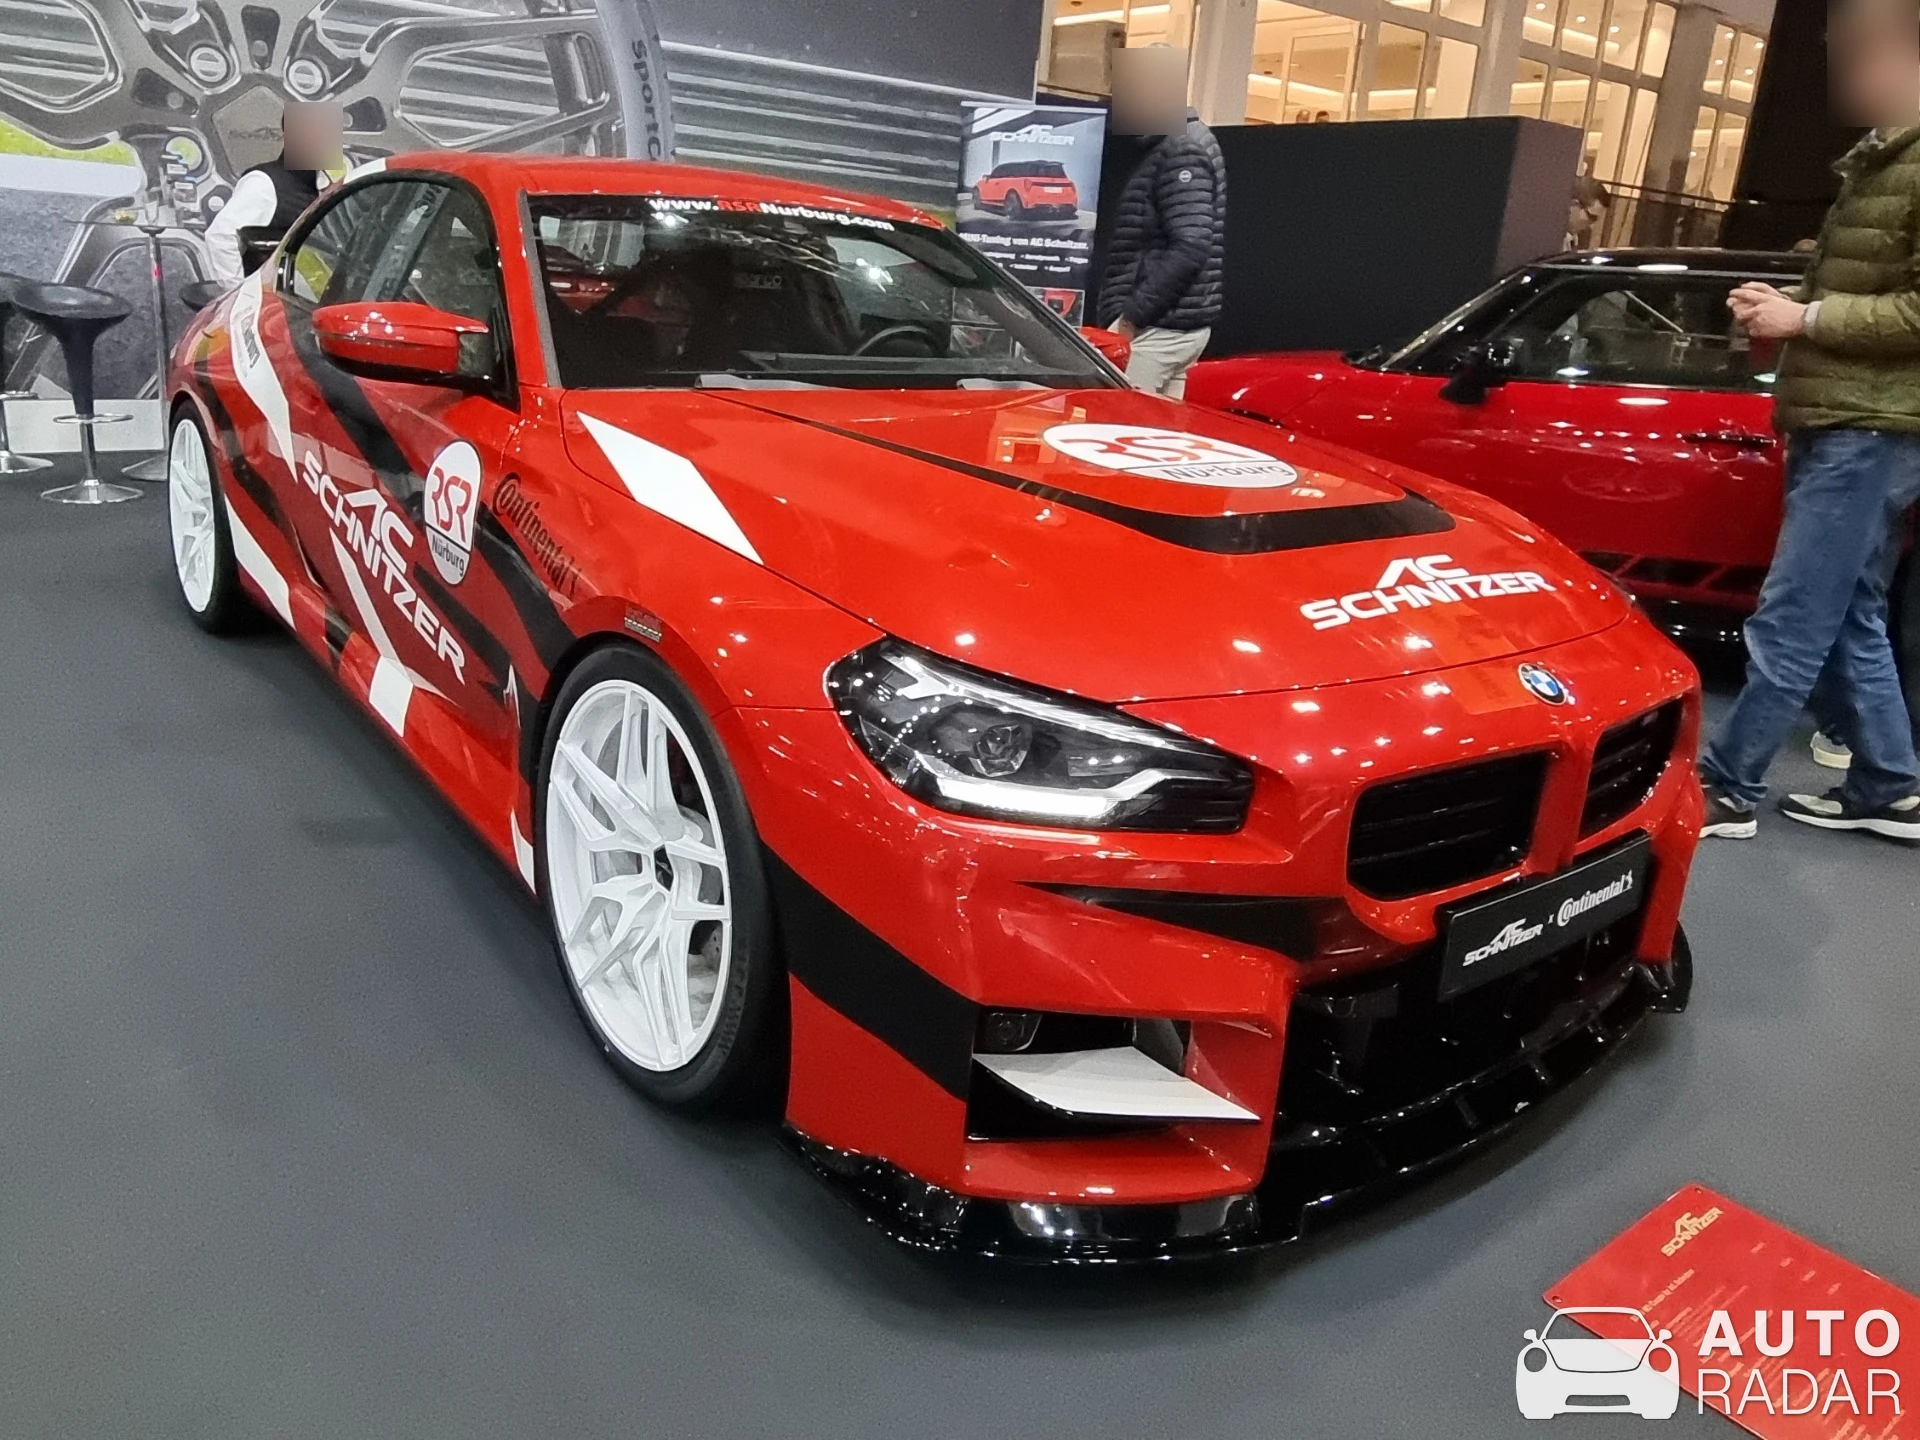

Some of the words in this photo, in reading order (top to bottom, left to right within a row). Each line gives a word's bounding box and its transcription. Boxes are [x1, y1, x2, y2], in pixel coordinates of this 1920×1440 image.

[648, 197, 896, 232] www.RSRNurburg.com
[1164, 463, 1294, 480] Nürburg
[343, 488, 414, 574] AC
[431, 535, 466, 578] Nürburg
[492, 472, 576, 596] Continental
[302, 450, 466, 686] SCHNITZER
[1375, 554, 1470, 590] AC
[1299, 571, 1557, 631] SCHNITZER
[1462, 923, 1544, 967] SCHNITZER
[1556, 873, 1626, 928] Continental
[1489, 917, 1527, 946] AC
[1660, 1206, 1724, 1257] SCHNITZER
